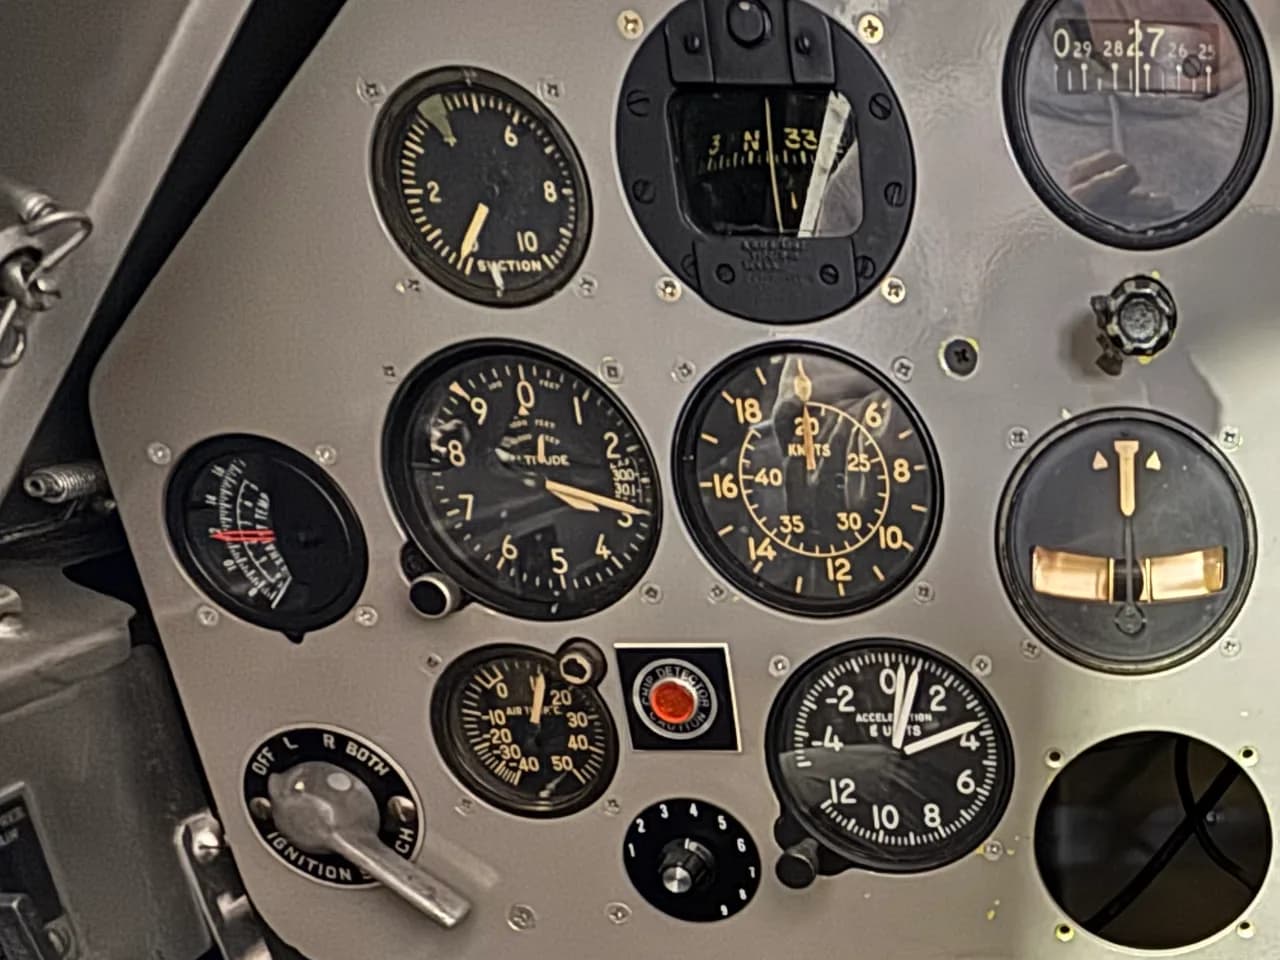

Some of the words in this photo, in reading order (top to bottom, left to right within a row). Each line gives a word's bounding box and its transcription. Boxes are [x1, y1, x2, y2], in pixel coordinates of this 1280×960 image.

[1103, 40, 1123, 57] 28
[1168, 42, 1188, 60] 26
[504, 126, 518, 147] 6
[743, 130, 760, 150] N
[470, 397, 488, 425] 9
[736, 398, 762, 424] 18
[788, 443, 832, 457] KNTS
[893, 459, 911, 482] 8
[551, 548, 569, 574] 5
[928, 684, 948, 711] 2
[282, 737, 299, 750] L
[322, 733, 337, 750] R
[252, 746, 276, 776] OFF
[345, 741, 390, 777] BOTH
[830, 777, 857, 805] 12
[636, 818, 646, 833] 2
[872, 804, 900, 831] 10
[266, 831, 353, 881] IGNITION
